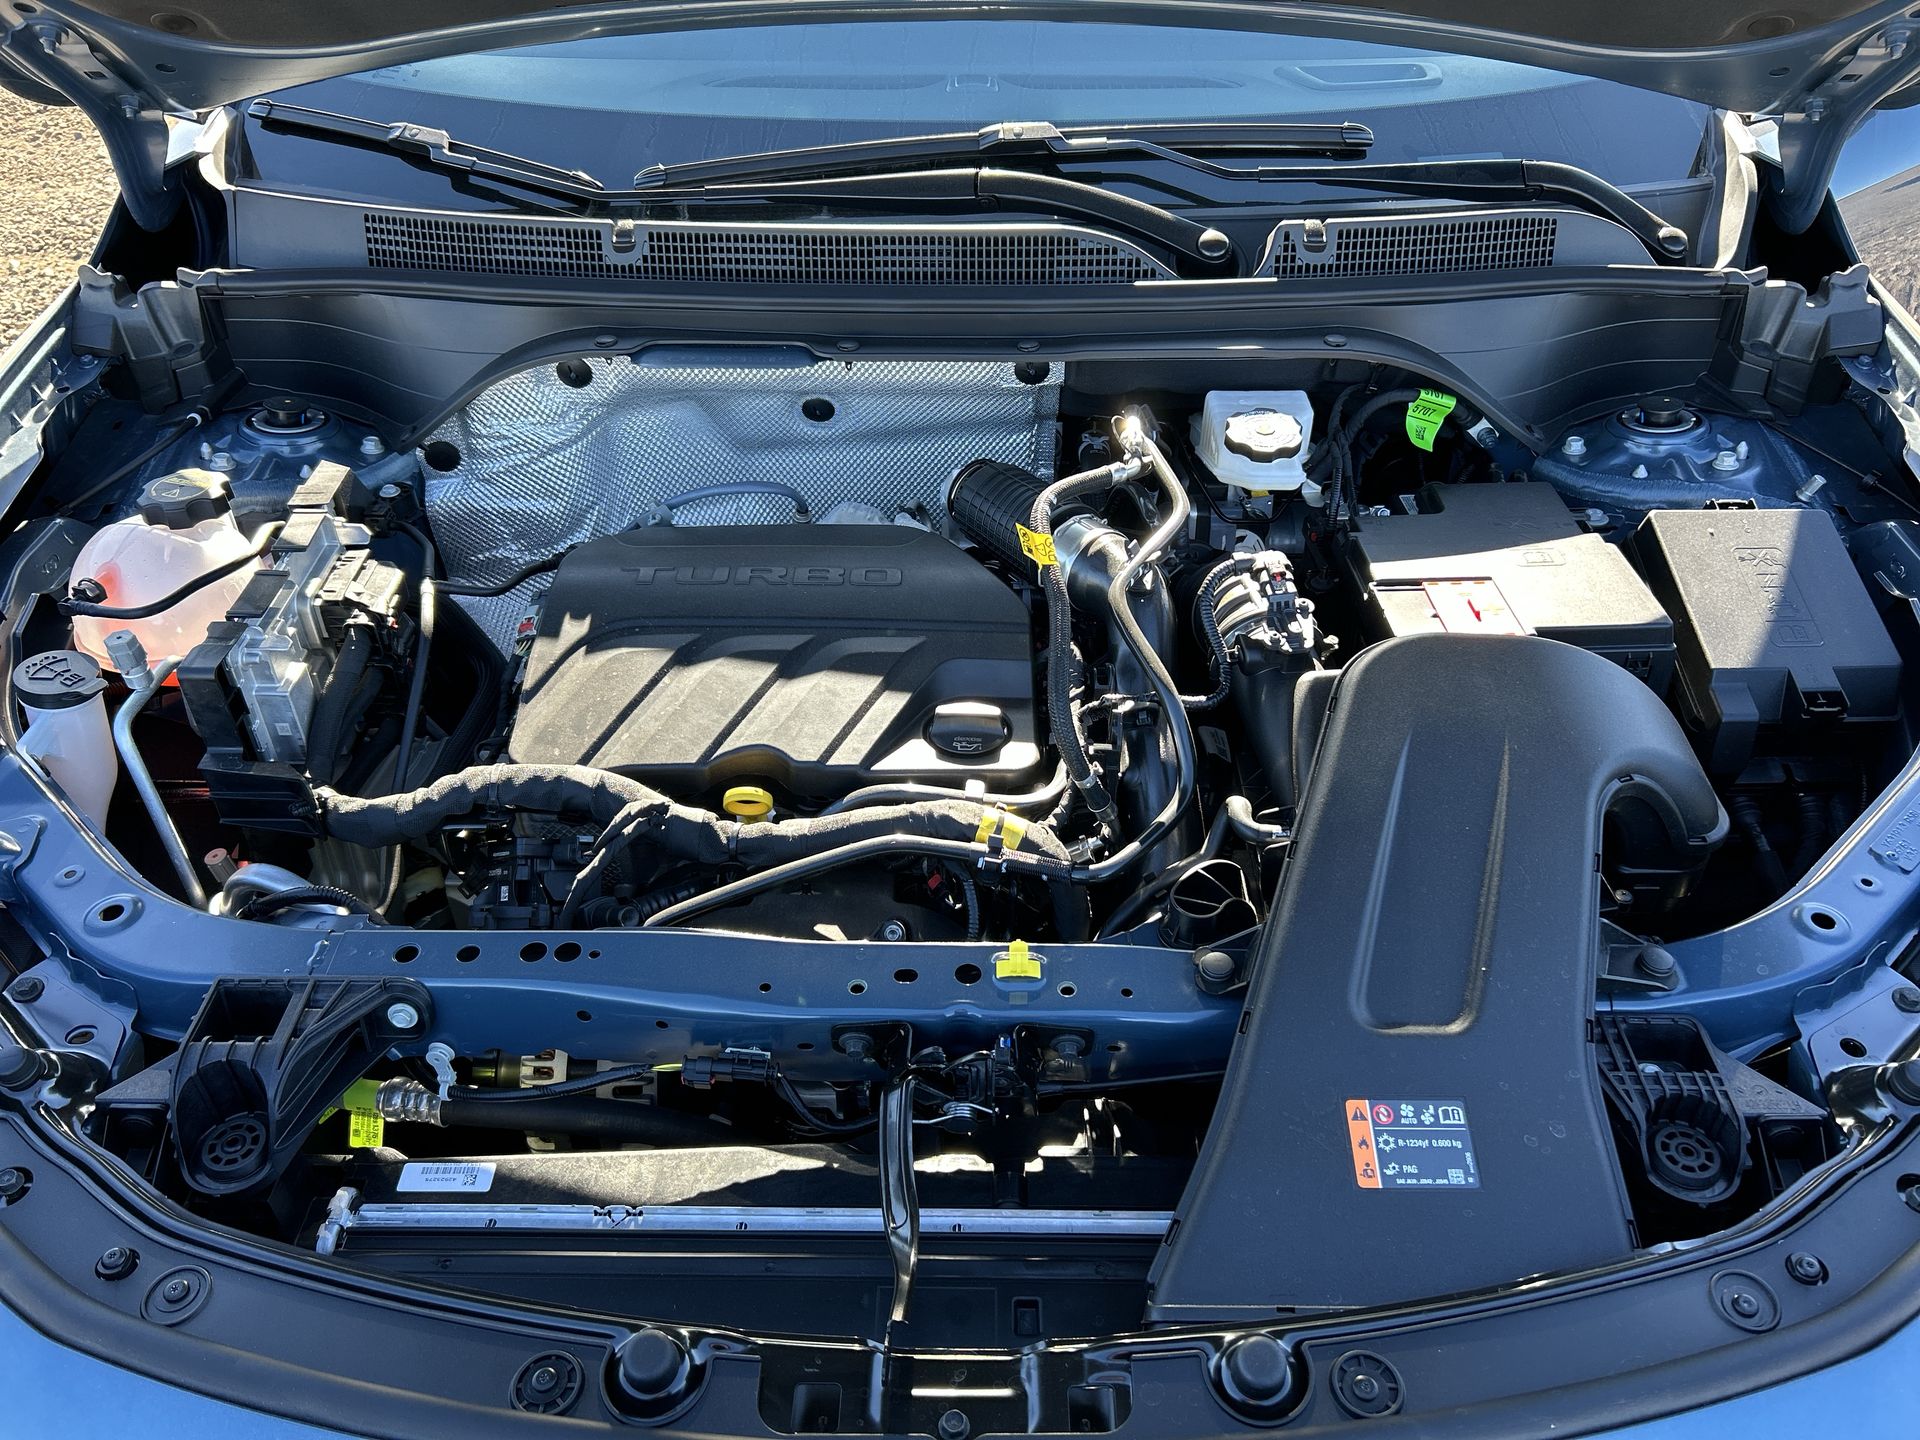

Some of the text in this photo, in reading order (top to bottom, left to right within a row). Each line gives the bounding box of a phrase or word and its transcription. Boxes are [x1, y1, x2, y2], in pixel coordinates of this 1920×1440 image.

[1412, 404, 1437, 417] 5707
[621, 566, 902, 586] TURBO
[1398, 1139, 1429, 1149] R-1234yf
[1452, 1139, 1462, 1149] kg
[1403, 1165, 1418, 1174] PAG
